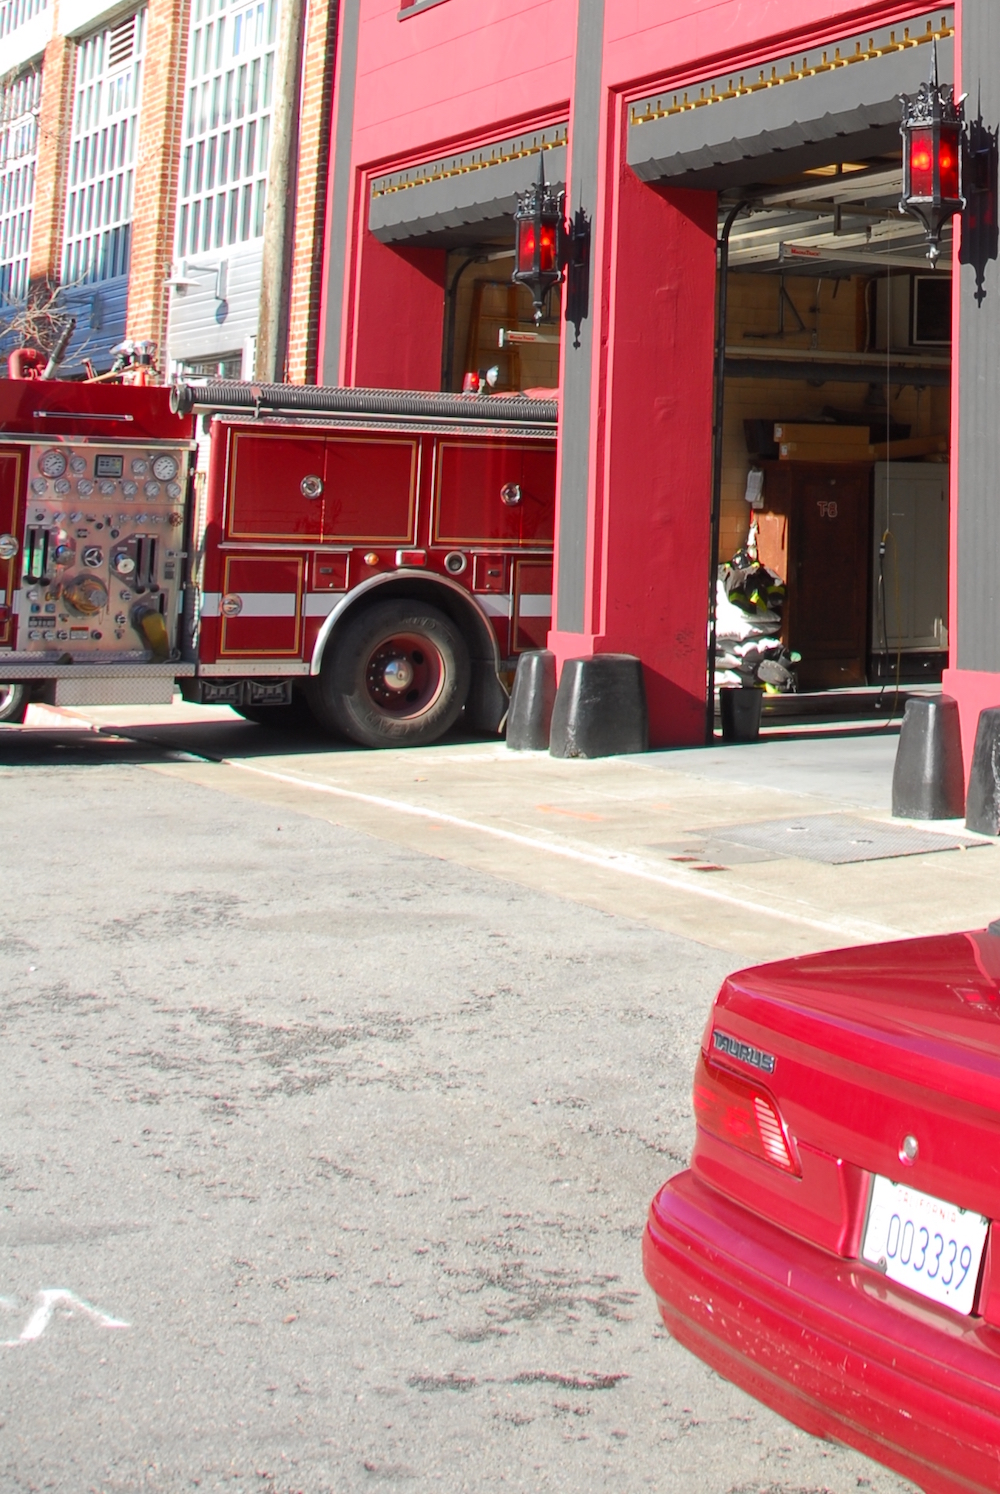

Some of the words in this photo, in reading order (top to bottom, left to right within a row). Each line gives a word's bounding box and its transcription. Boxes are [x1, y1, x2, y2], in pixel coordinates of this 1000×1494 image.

[713, 1029, 776, 1074] TAURUS
[898, 1189, 957, 1223] CALIFORNIA
[886, 1213, 972, 1291] 003339
